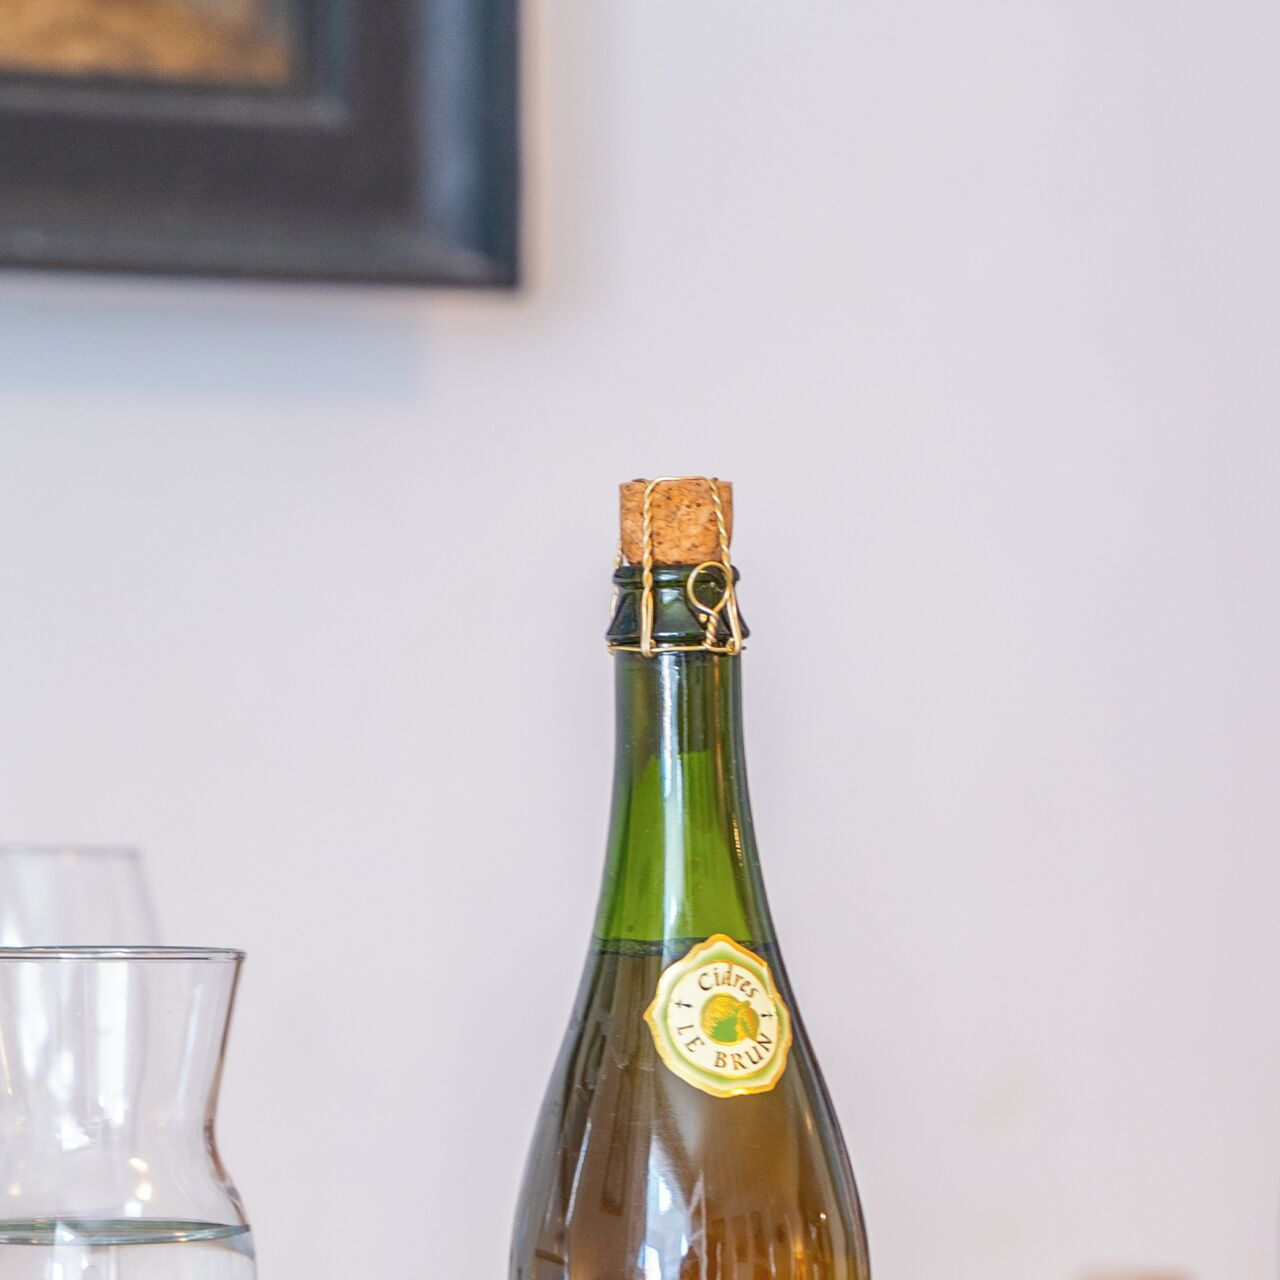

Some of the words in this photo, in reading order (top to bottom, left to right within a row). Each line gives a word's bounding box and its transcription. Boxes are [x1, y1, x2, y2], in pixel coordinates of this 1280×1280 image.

[697, 963, 760, 998] Cidres
[677, 1023, 705, 1053] LE
[713, 1032, 774, 1071] BRUN
